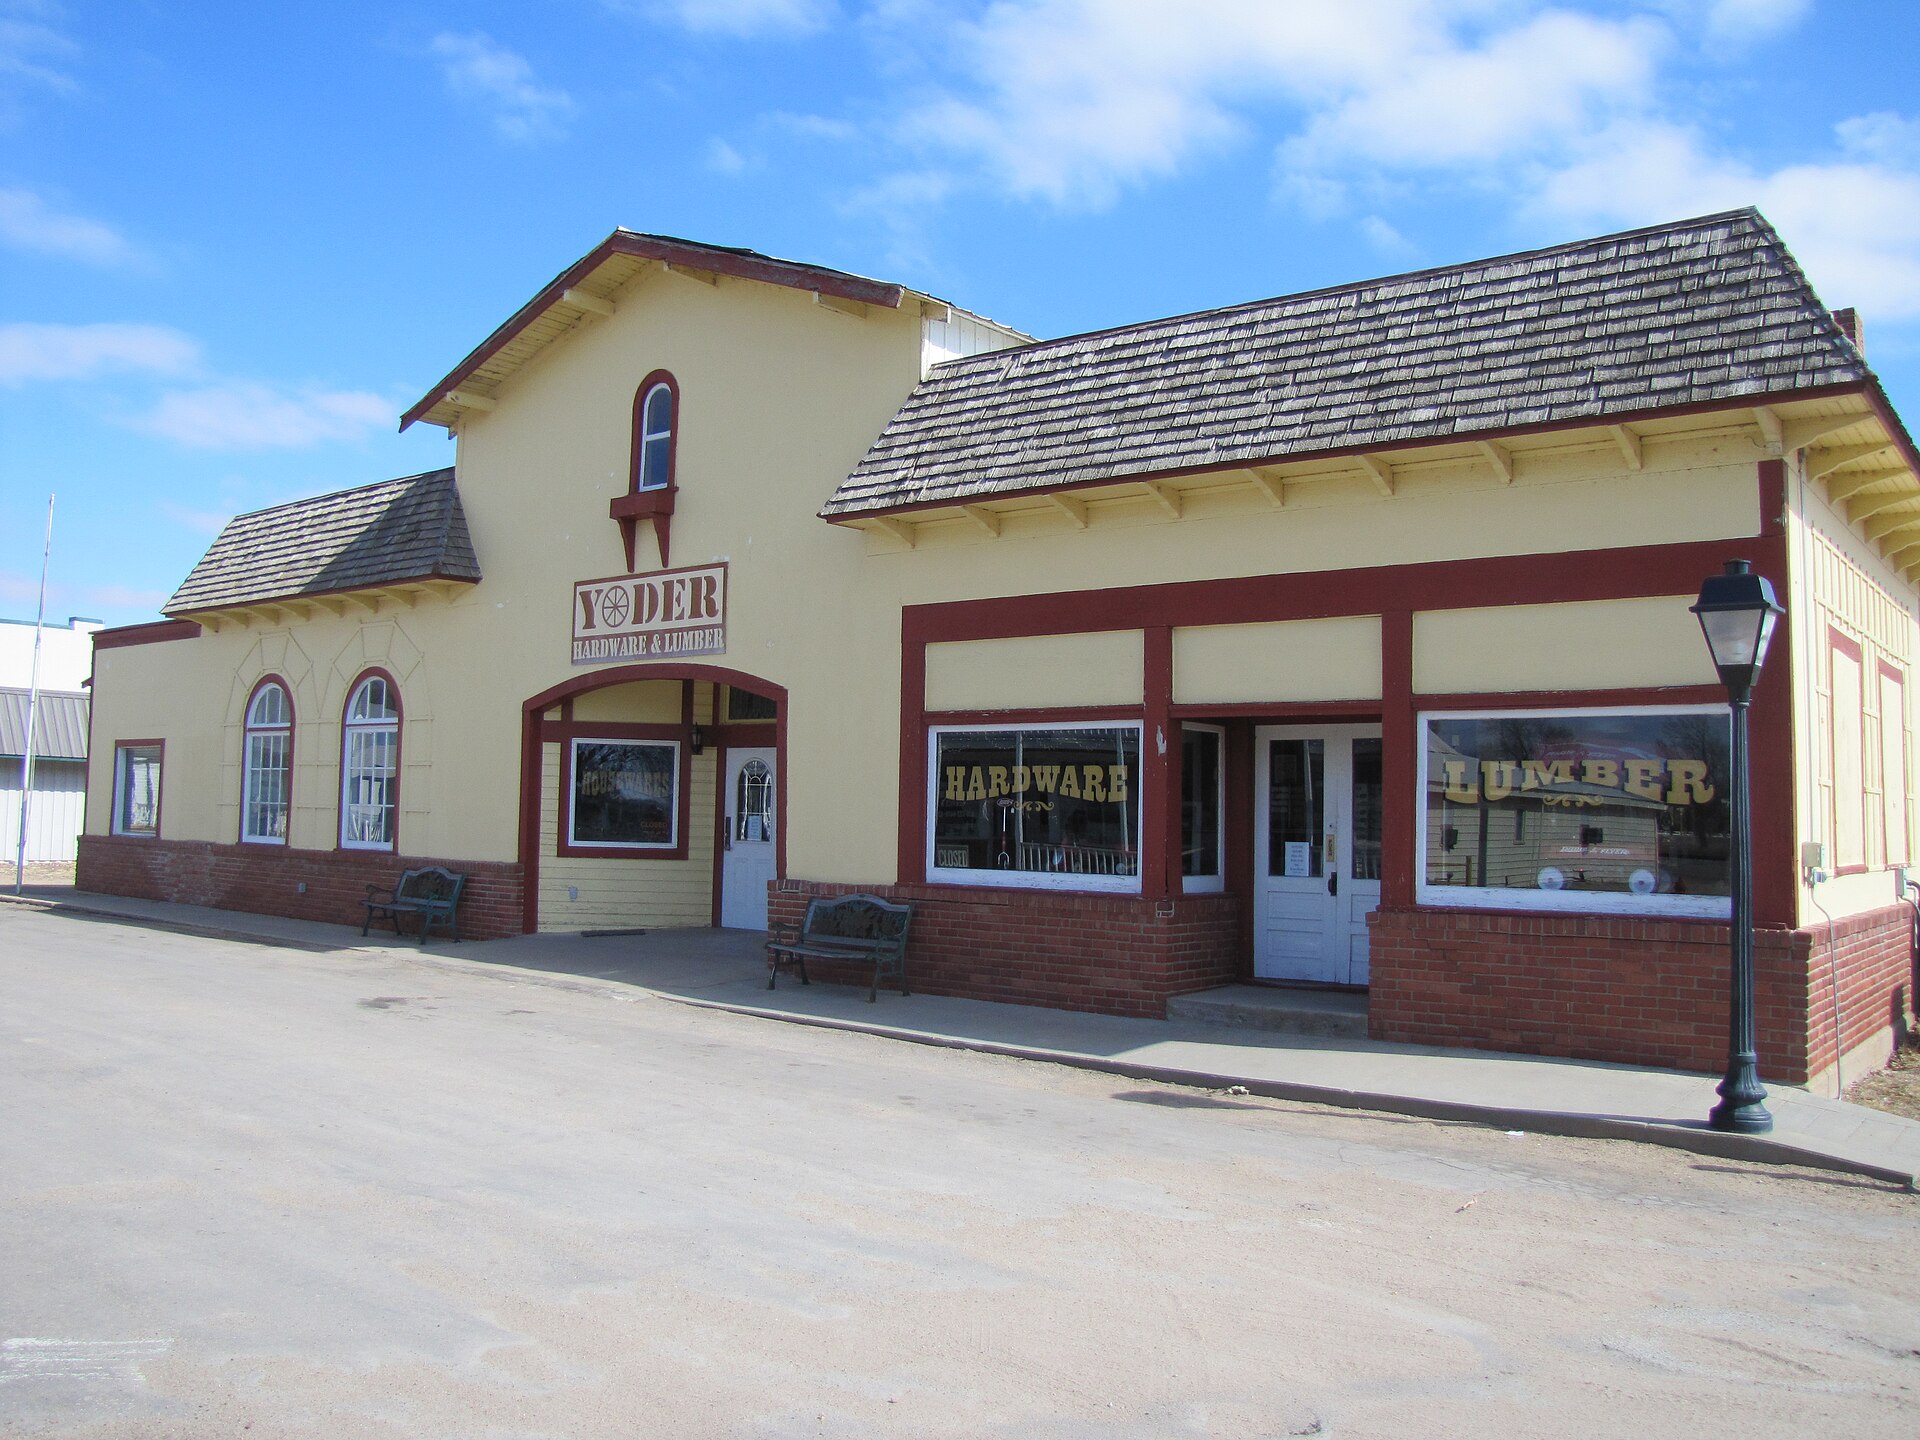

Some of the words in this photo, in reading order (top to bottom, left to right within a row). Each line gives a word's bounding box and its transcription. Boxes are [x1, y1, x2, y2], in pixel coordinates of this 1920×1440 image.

[573, 635, 647, 660] HARDWARE
[650, 634, 661, 653] &
[664, 628, 725, 653] LUMBER
[946, 765, 1128, 803] HARDWARE
[1445, 759, 1714, 805] LUMBER
[939, 849, 968, 867] CLOSED
